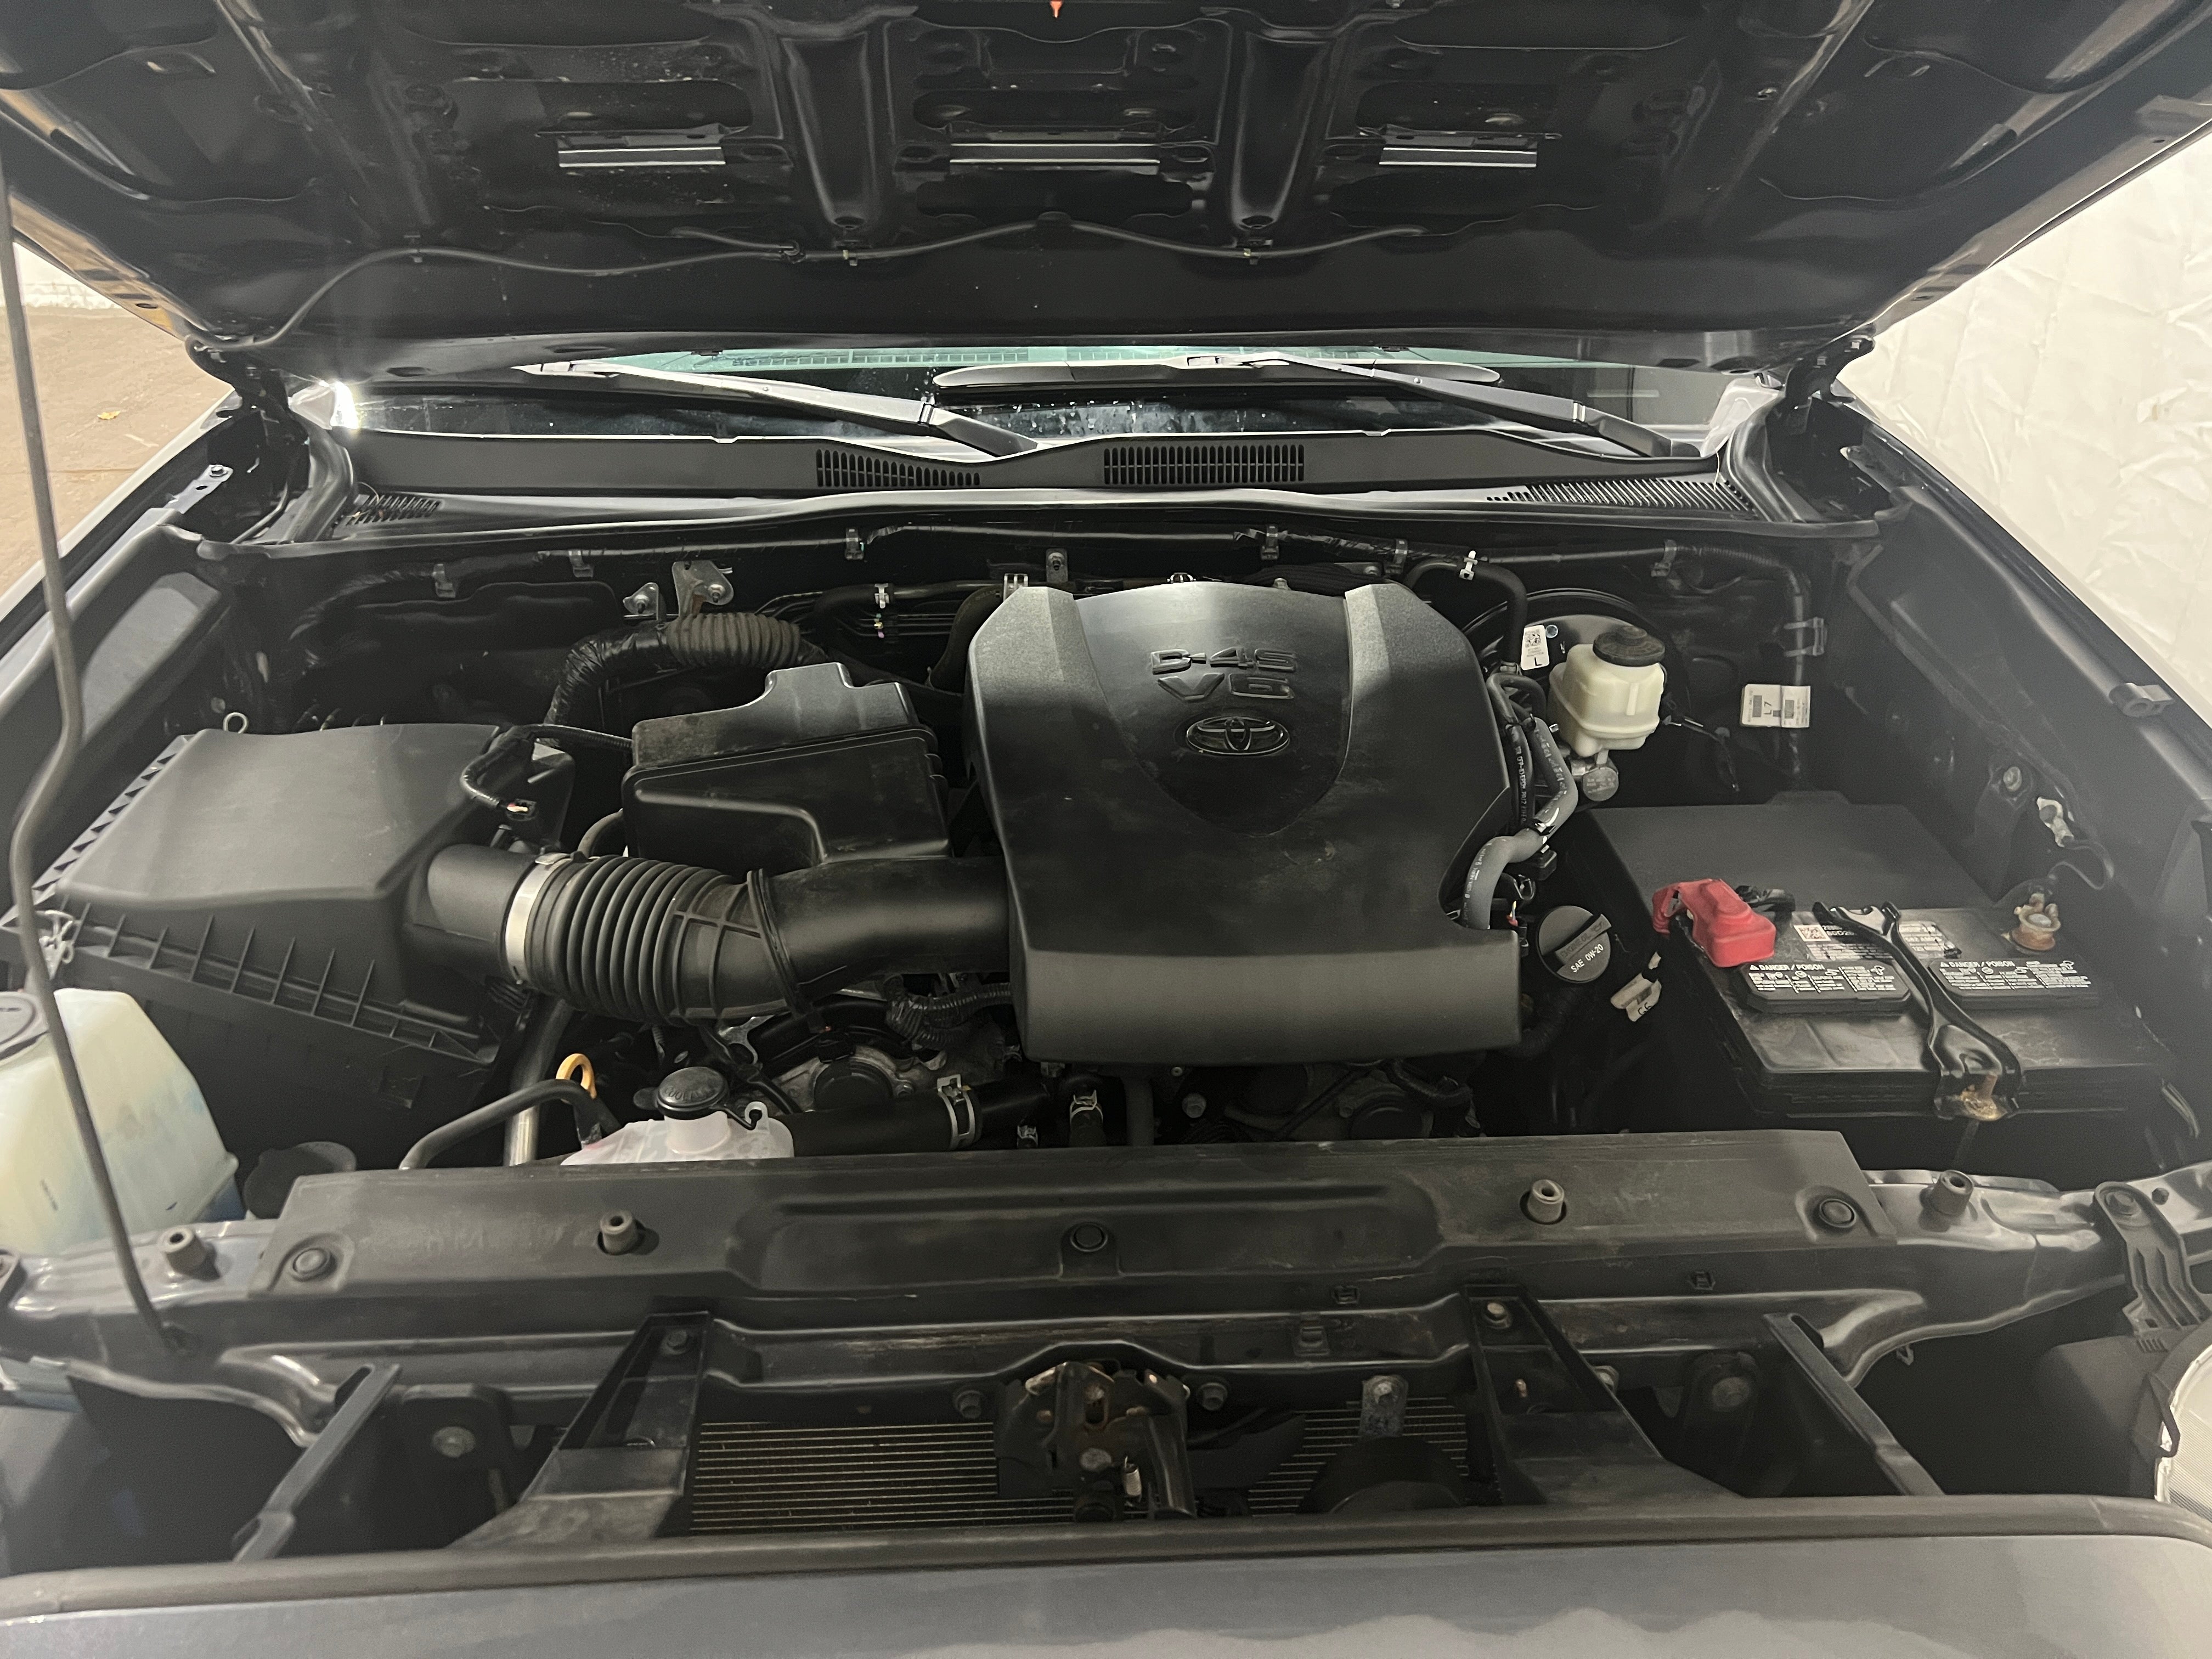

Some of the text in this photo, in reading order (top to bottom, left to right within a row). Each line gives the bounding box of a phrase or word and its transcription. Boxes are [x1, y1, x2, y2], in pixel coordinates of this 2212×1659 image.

[1150, 647, 1299, 675] D-4S
[1534, 657, 1542, 667] L
[1157, 673, 1296, 701] V6
[1571, 944, 1604, 973] SAE 0W-20
